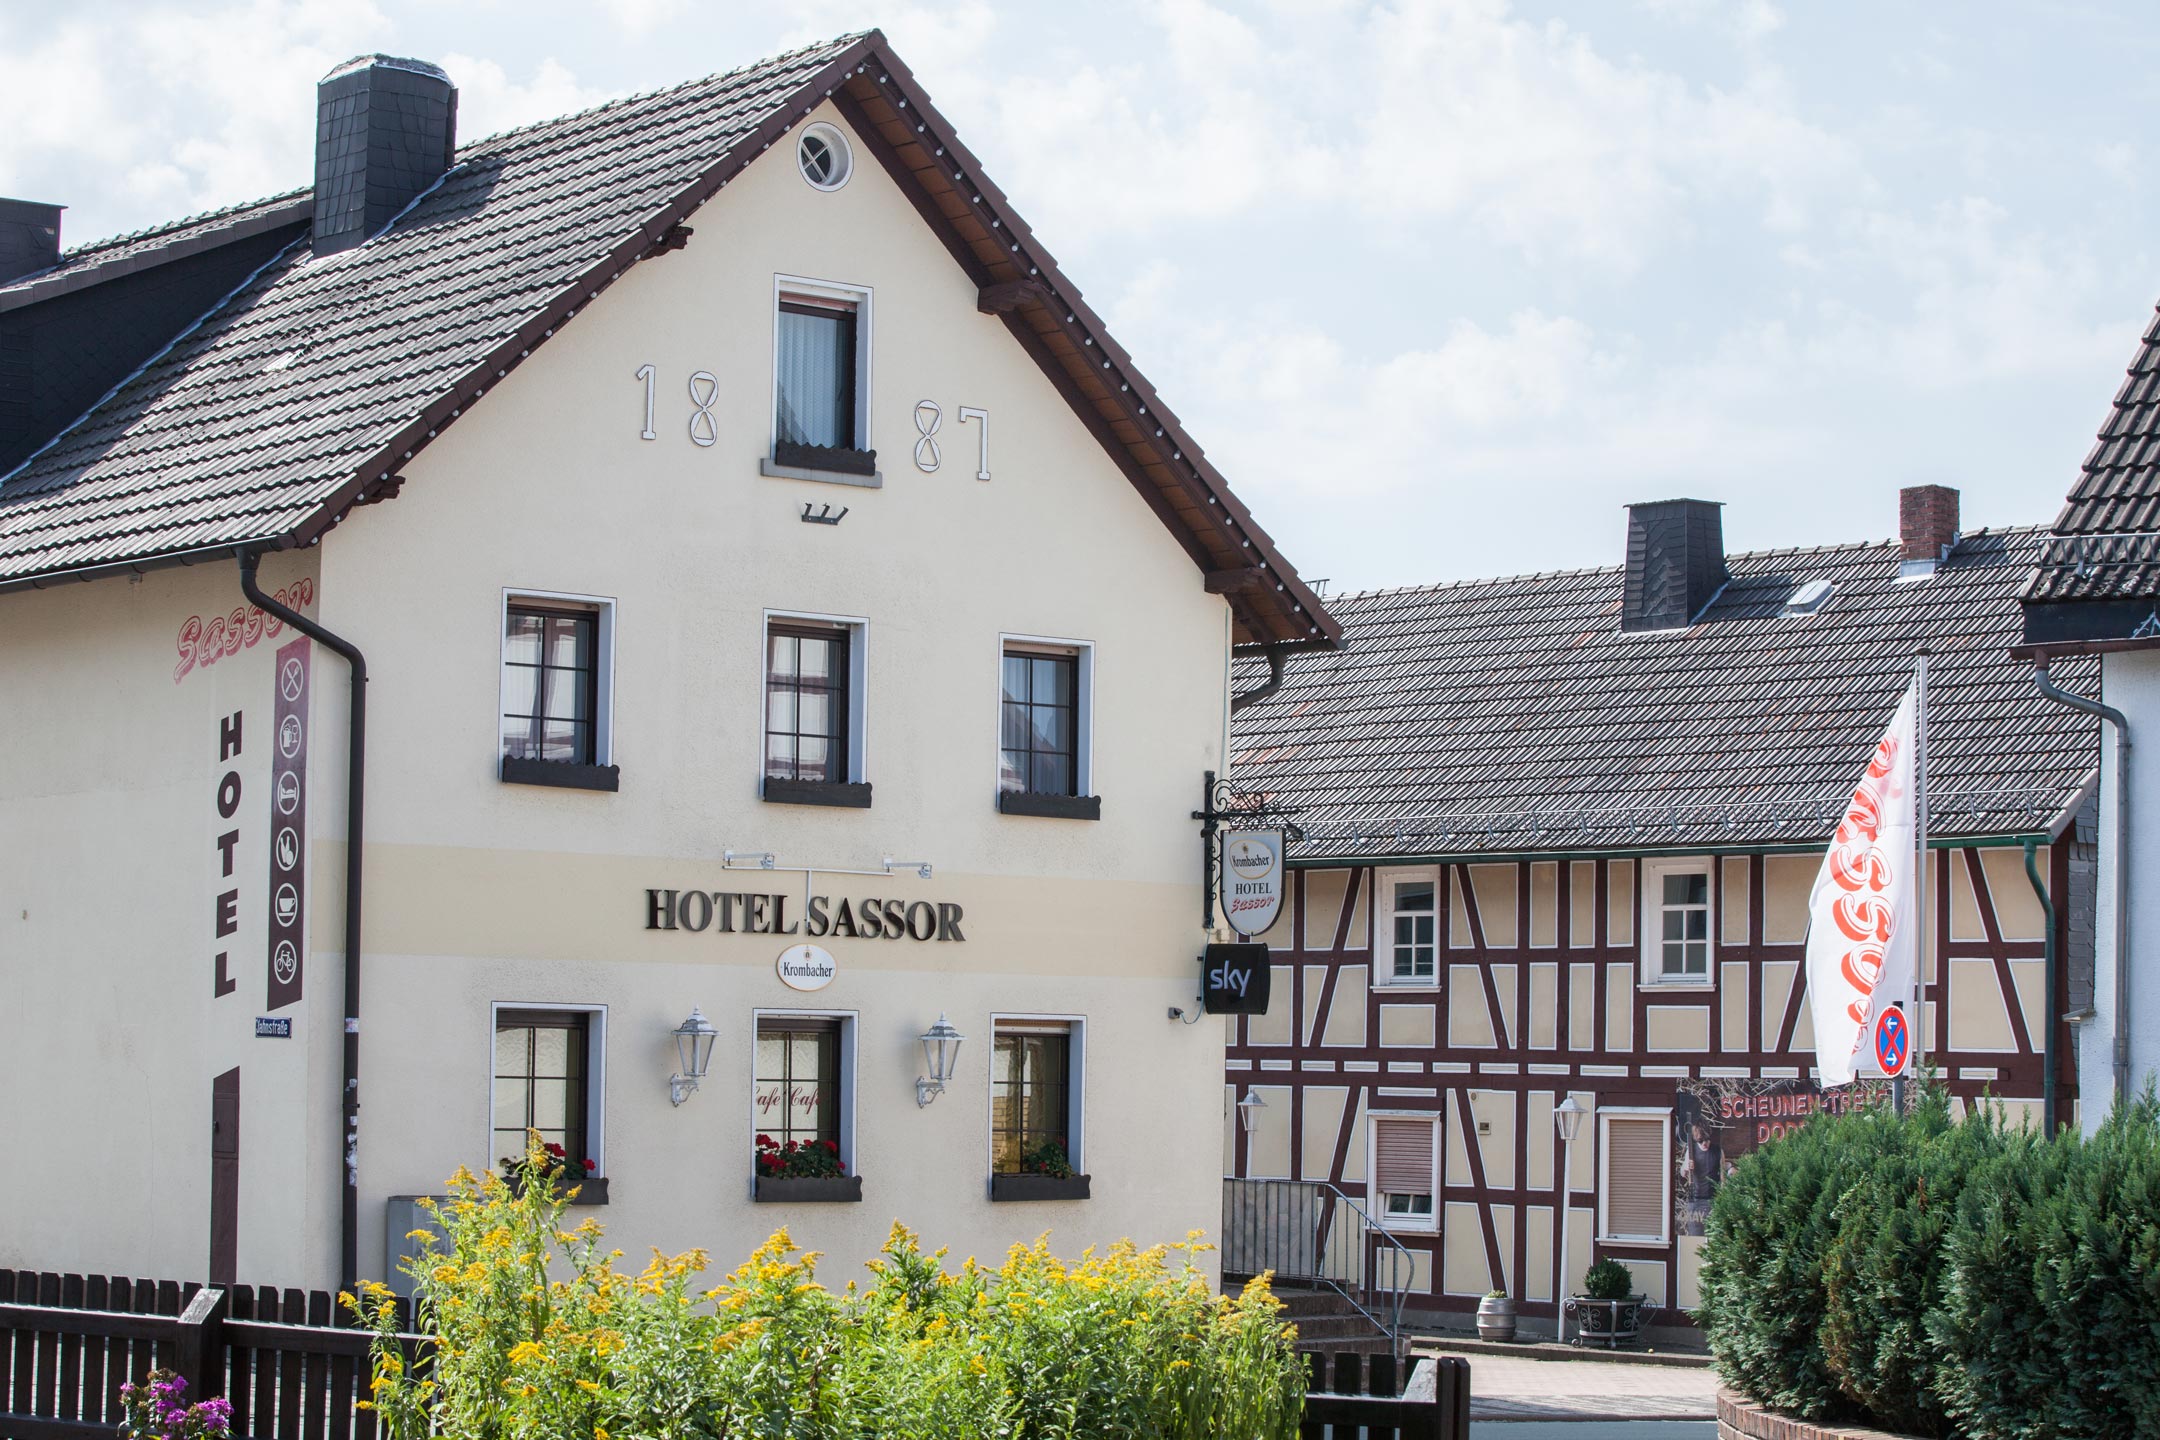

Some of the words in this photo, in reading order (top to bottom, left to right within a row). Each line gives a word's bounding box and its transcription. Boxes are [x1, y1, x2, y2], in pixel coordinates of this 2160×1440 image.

[214, 709, 243, 999] HOTEL
[1231, 853, 1270, 868] Krombacher
[1235, 882, 1273, 895] HOTEL
[645, 888, 799, 935] HOTEL
[806, 895, 967, 943] SASSOR
[783, 961, 833, 978] Krombacher
[1209, 959, 1252, 998] sky
